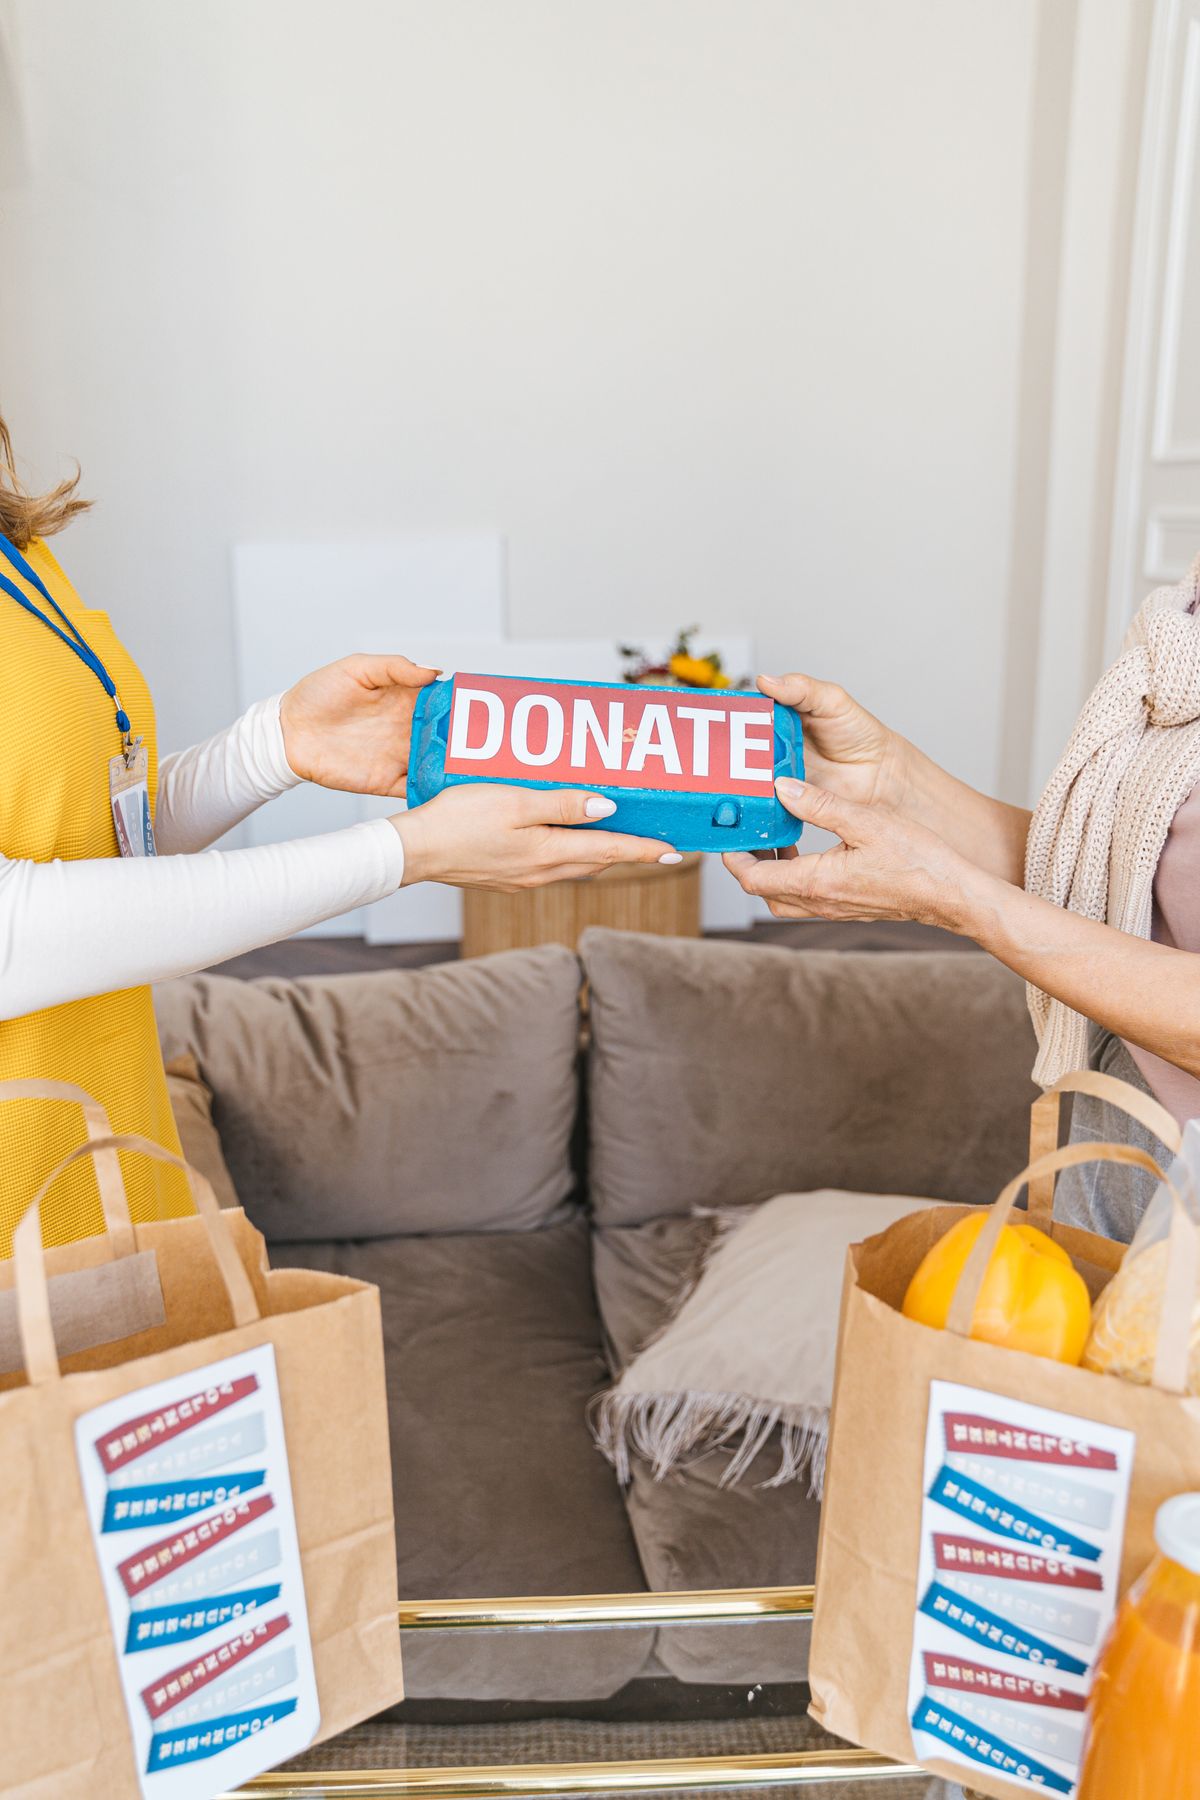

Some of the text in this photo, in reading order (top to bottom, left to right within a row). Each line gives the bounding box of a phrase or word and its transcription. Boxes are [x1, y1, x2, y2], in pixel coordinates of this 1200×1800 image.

[449, 687, 773, 782] DONATE
[106, 1380, 233, 1460] VOLUNTEER
[953, 1423, 1092, 1457] VOLUNTEER
[114, 1485, 240, 1520] VOLUNTEER
[943, 1480, 1072, 1555] VOLUNTEER
[128, 1502, 250, 1584] VOLUNTEER
[942, 1544, 1077, 1577] VOLUNTEER
[137, 1600, 257, 1640] VOLUNTEER
[933, 1595, 1059, 1668] VOLUNTEER
[152, 1623, 267, 1707] VOLUNTEER
[933, 1662, 1062, 1698] VOLUNTEER
[159, 1714, 274, 1760] VOLUNTEER
[925, 1709, 1046, 1784] VOLUNTEER
